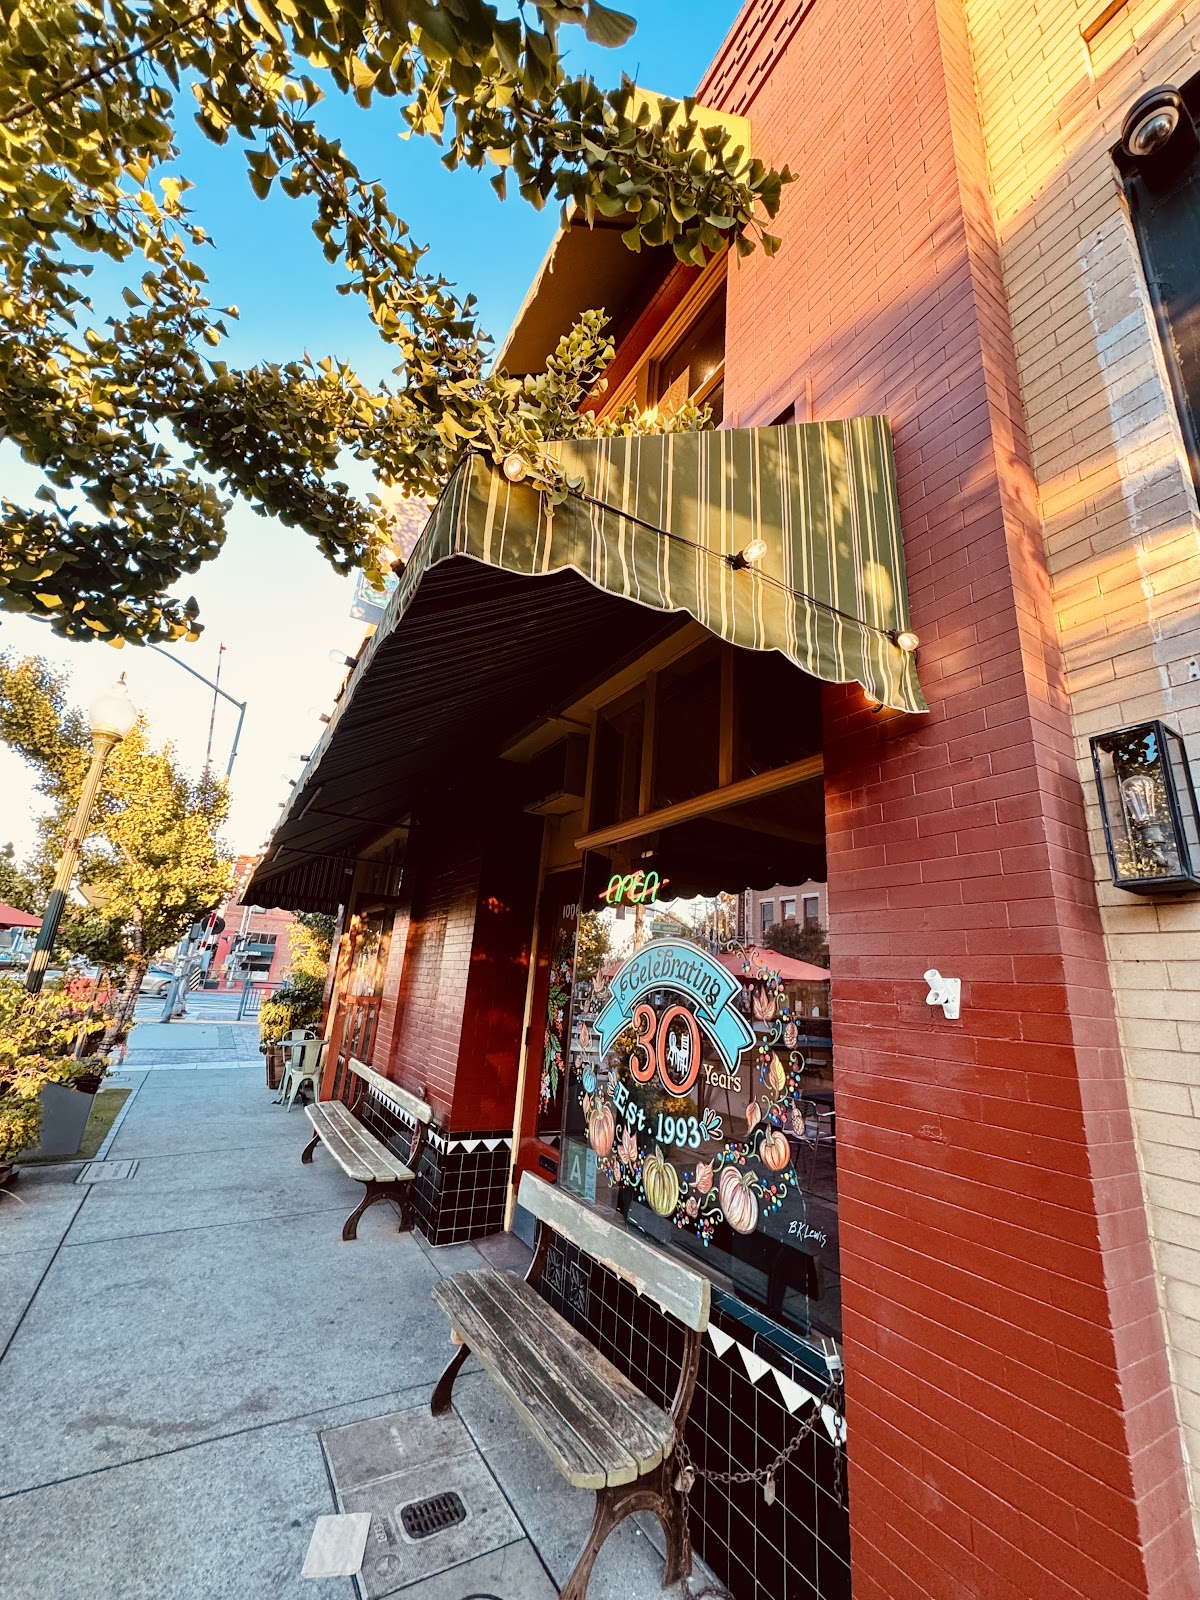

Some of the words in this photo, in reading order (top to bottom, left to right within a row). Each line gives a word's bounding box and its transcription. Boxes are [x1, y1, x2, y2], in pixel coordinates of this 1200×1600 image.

[605, 870, 660, 904] OPEN
[619, 948, 722, 1011] Celebrating
[629, 1003, 703, 1097] 30
[703, 1063, 743, 1094] Years
[655, 1112, 702, 1149] 1993
[569, 1154, 582, 1186] A
